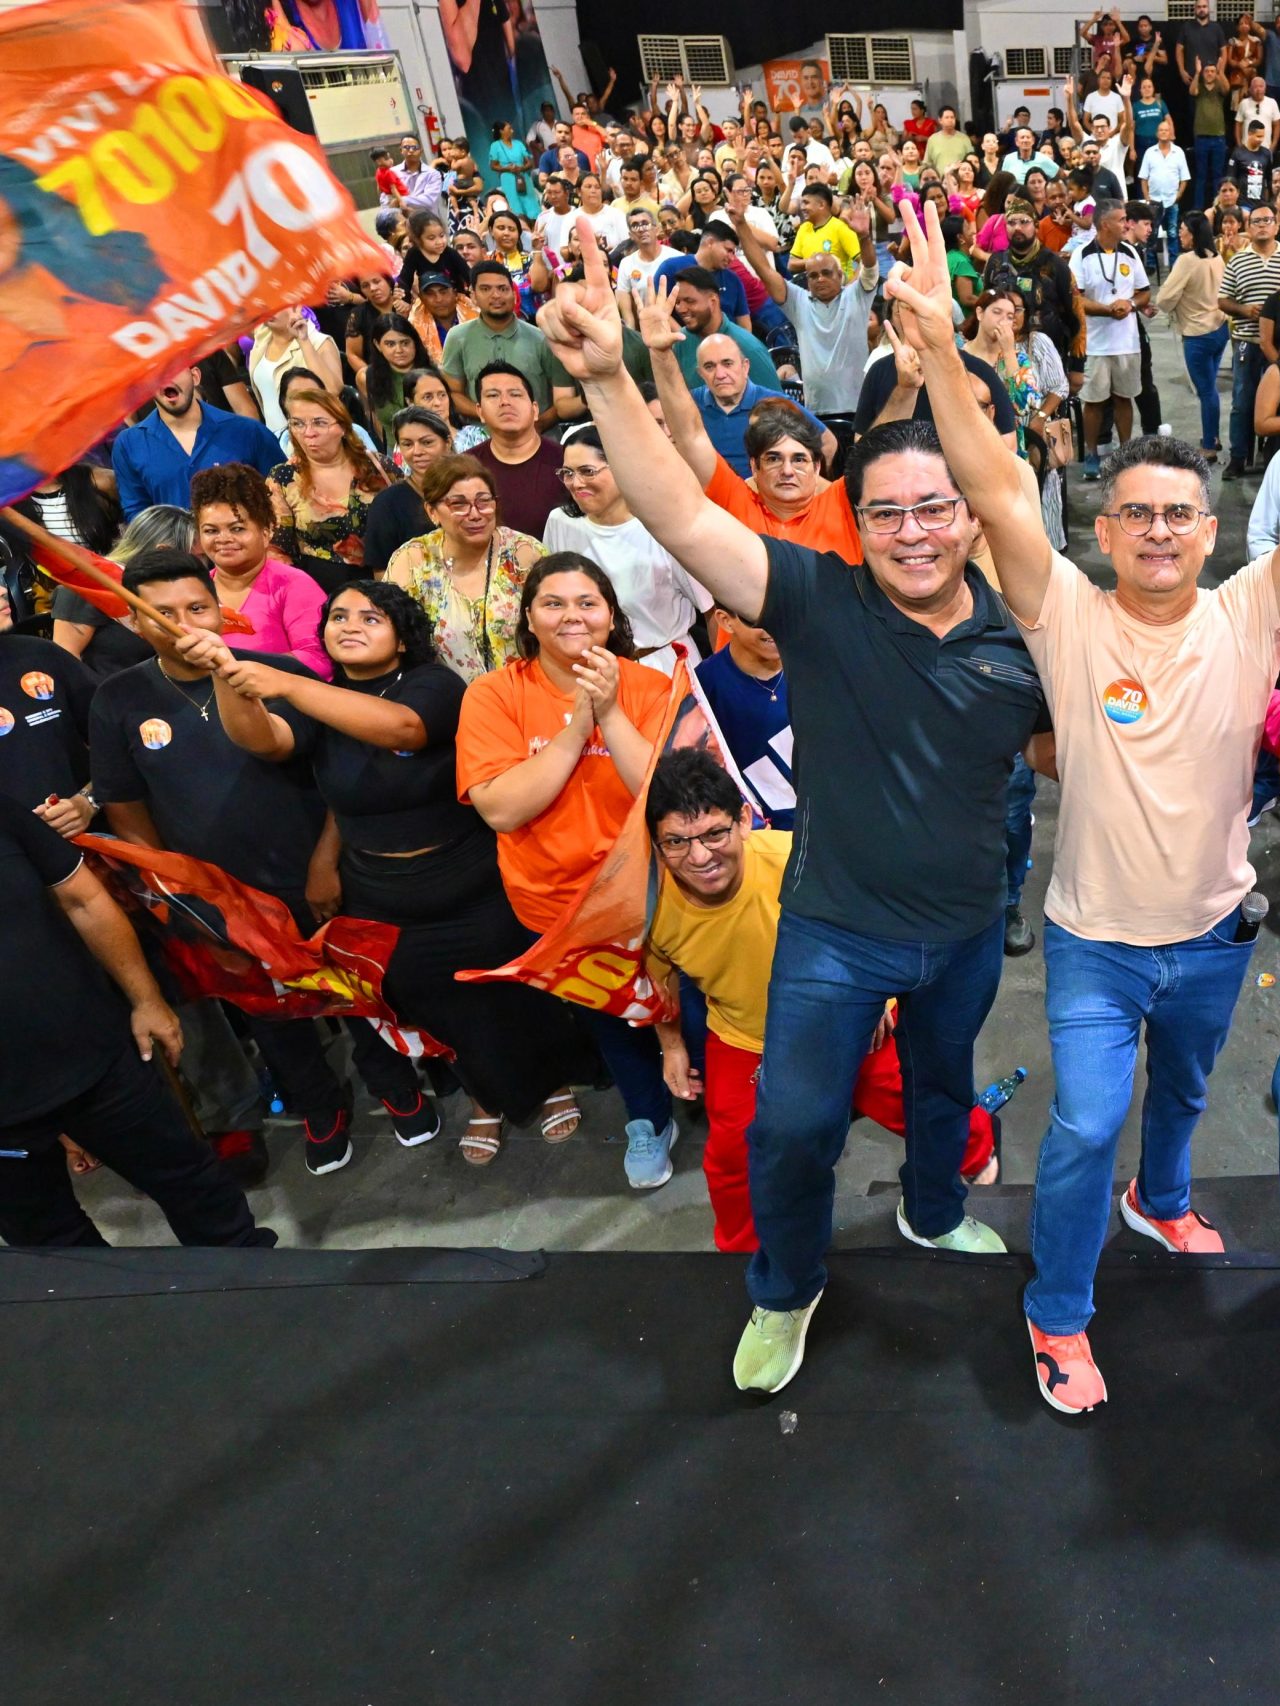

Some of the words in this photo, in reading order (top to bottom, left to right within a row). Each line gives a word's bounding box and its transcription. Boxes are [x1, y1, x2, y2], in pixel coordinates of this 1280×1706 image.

[34, 74, 278, 236] 70100
[109, 250, 260, 358] DAVID
[209, 141, 344, 270] 70
[1107, 696, 1140, 711] DAVID
[1122, 687, 1143, 703] 70
